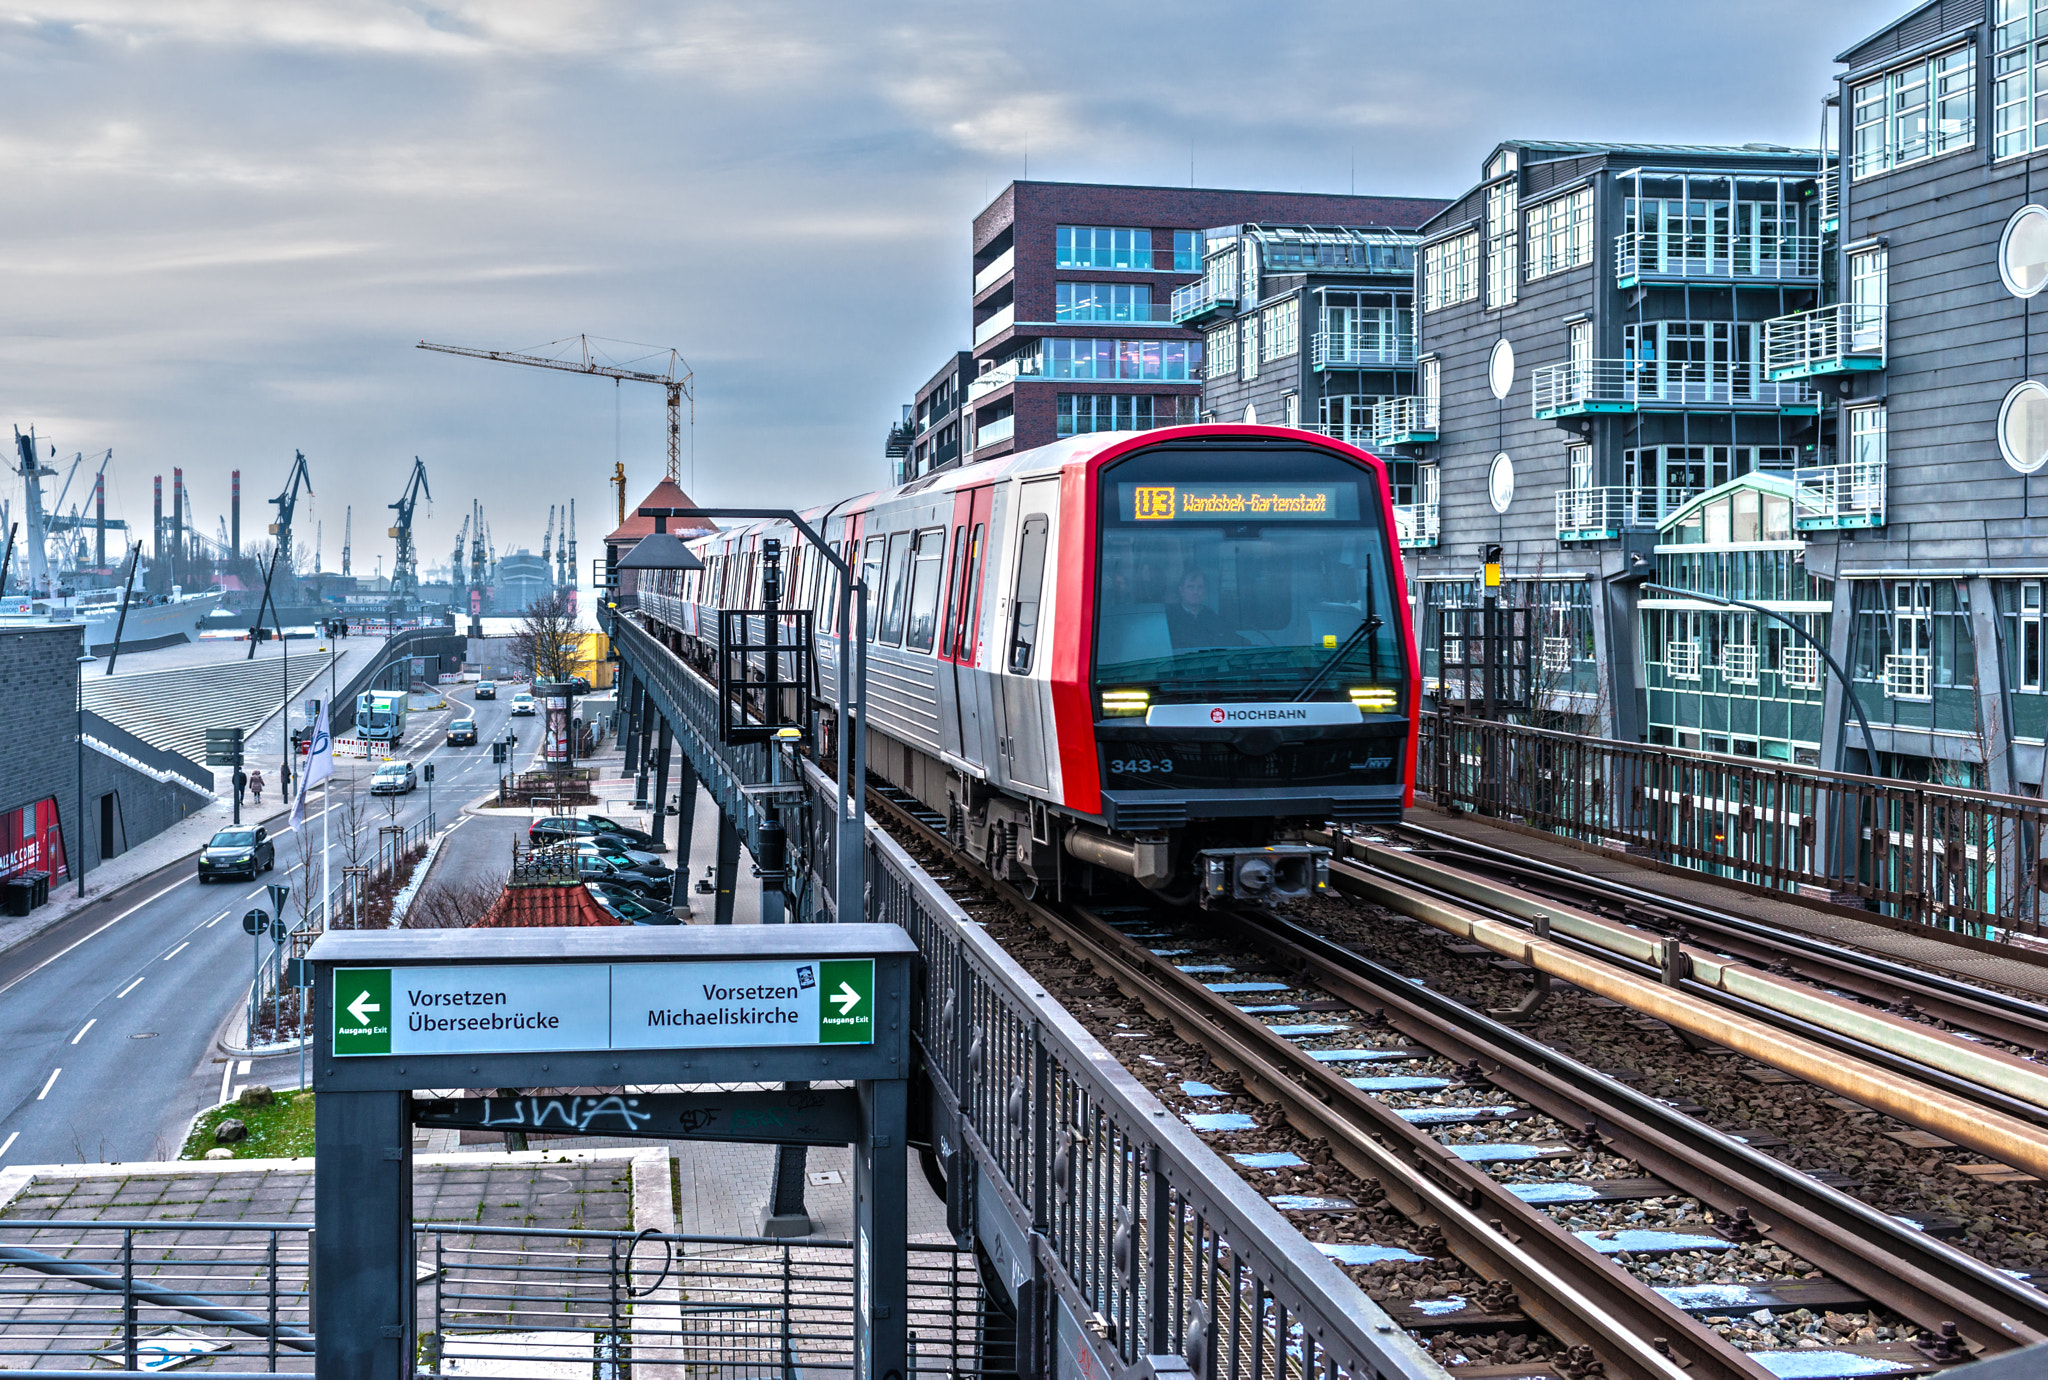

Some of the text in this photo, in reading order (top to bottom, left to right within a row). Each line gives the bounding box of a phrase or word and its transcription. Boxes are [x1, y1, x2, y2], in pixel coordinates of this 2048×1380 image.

[1138, 490, 1327, 516] U3 Wandsbek-Gartenstadt
[1227, 709, 1306, 720] HOCHBAHN
[1111, 759, 1173, 773] 343-3
[408, 990, 507, 1006] Vorsetzen
[702, 984, 798, 1001] Vorsetzen
[408, 1012, 559, 1032] Überseebrücke
[647, 1007, 799, 1027] Michaeliskirche
[822, 1016, 869, 1025] Ausgang Exit
[339, 1026, 387, 1036] Ausgang Exit
